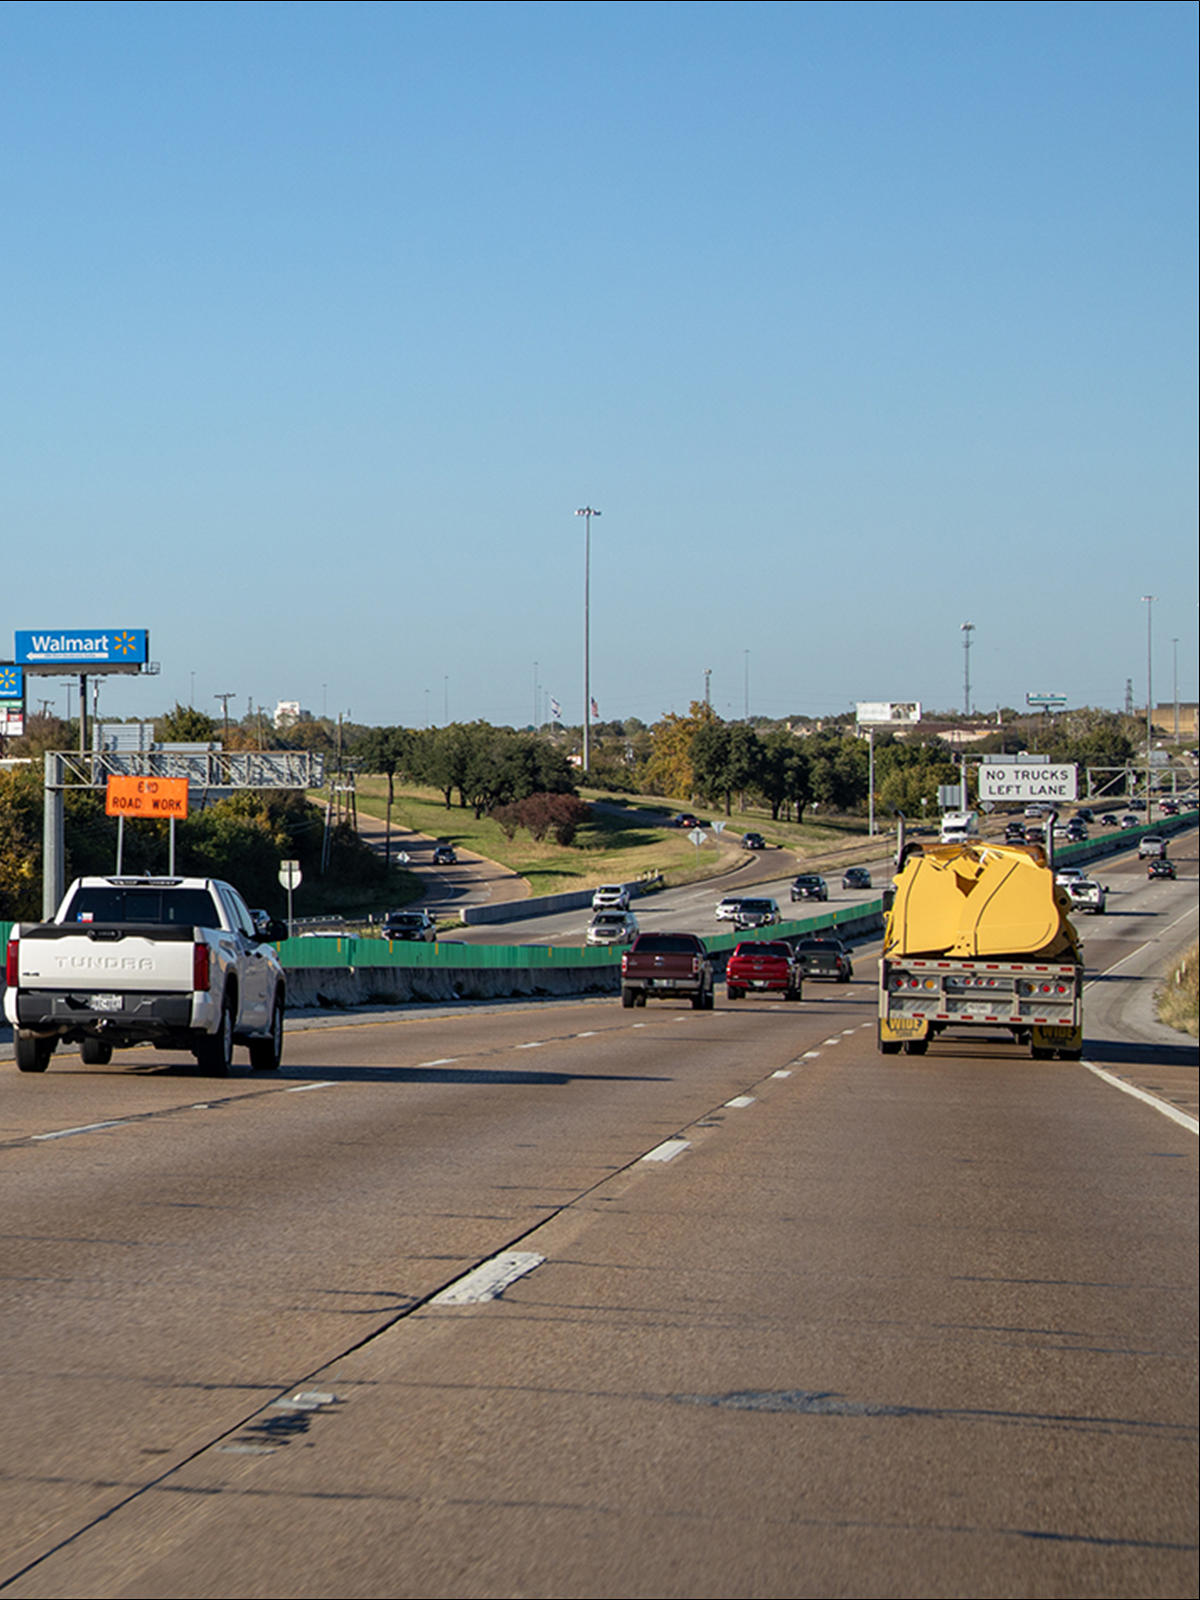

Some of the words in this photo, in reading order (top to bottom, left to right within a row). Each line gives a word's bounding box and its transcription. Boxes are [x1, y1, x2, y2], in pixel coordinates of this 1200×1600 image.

[31, 635, 109, 652] Walmart
[986, 770, 1006, 781] NO
[1013, 770, 1069, 781] TRUCKS
[988, 785, 1022, 795] LEFT
[1029, 785, 1067, 795] LANE
[111, 796, 142, 810] ROAD
[151, 798, 183, 811] WORK
[54, 956, 155, 970] TUNDRA
[889, 1018, 919, 1030] WIDE
[1042, 1025, 1073, 1038] WIDE
